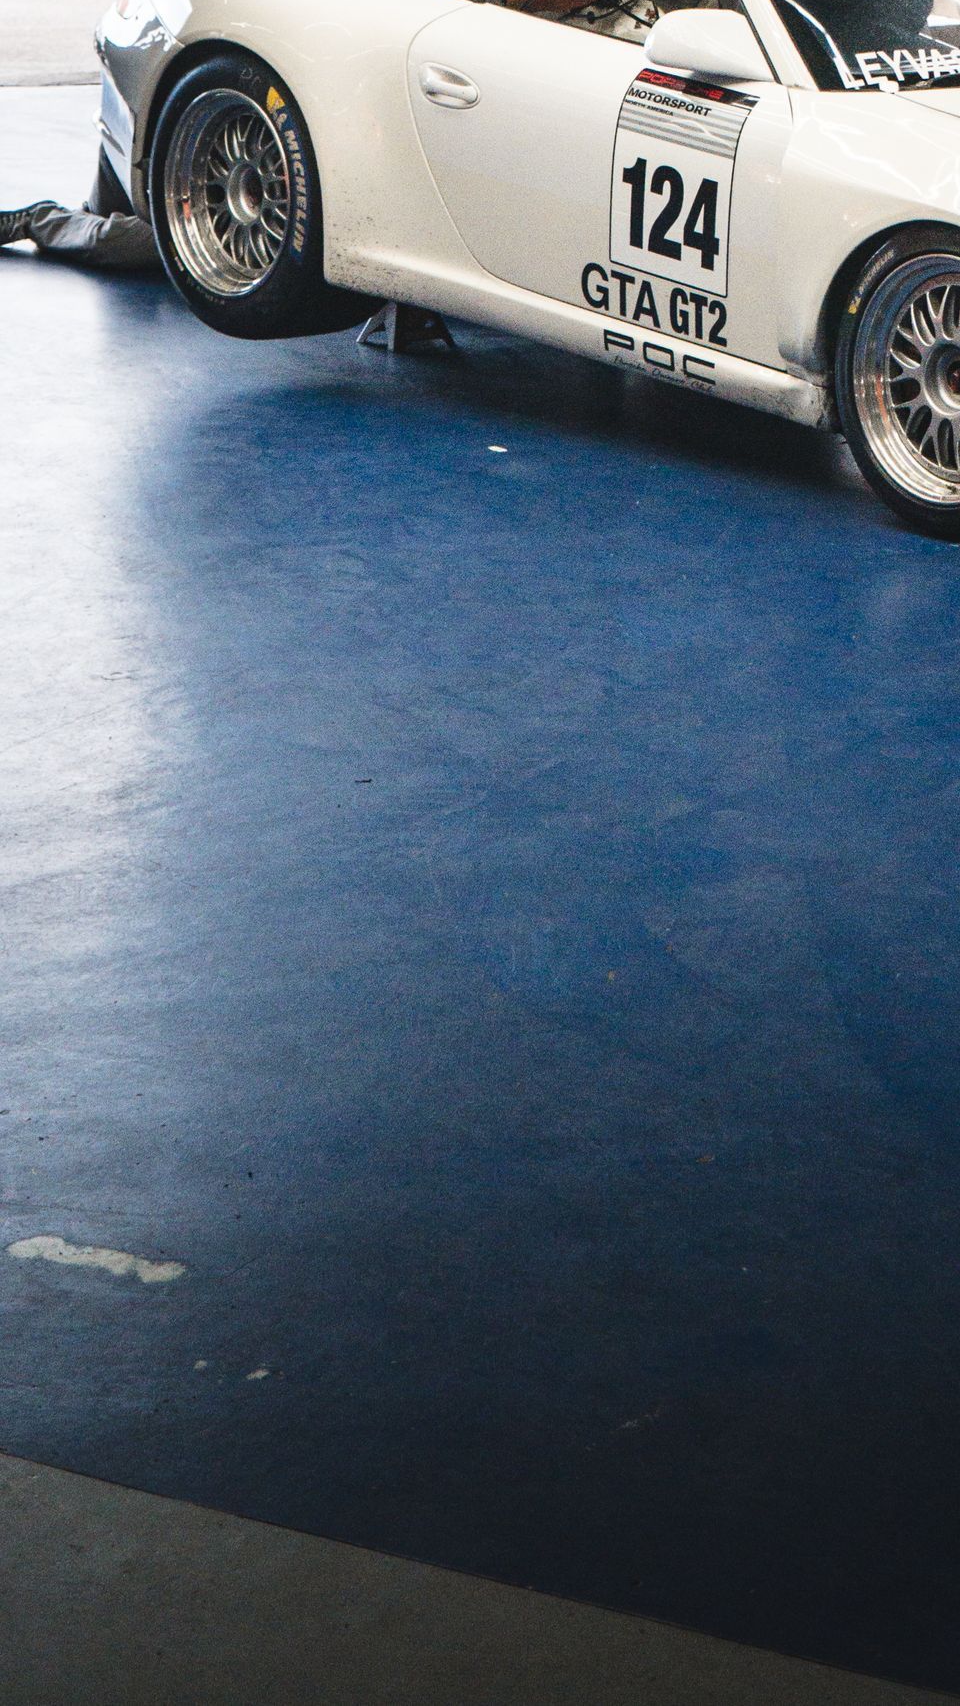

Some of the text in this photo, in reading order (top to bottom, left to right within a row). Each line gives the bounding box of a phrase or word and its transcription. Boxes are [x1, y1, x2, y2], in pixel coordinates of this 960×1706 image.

[629, 87, 712, 117] MOTORSPORT
[647, 105, 674, 117] AMERICA
[284, 129, 307, 253] MICHELIN
[622, 157, 720, 271] 124
[581, 262, 727, 348] GTA GT2
[604, 329, 716, 385] POC
